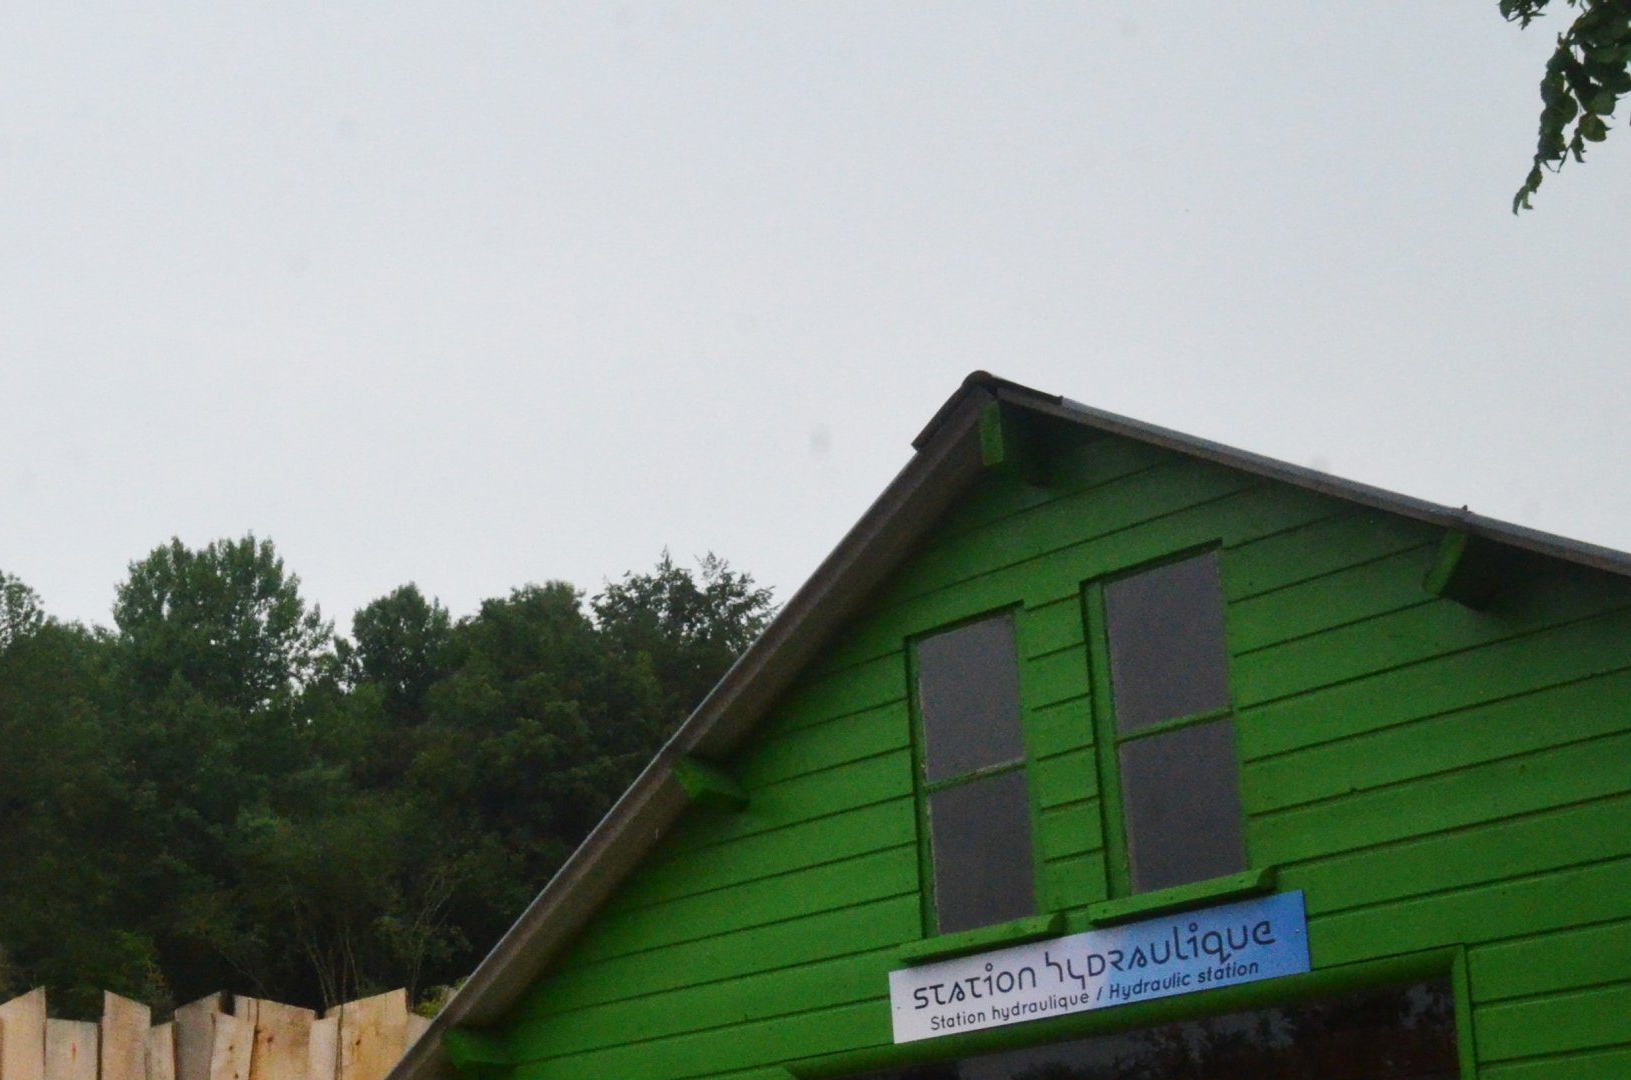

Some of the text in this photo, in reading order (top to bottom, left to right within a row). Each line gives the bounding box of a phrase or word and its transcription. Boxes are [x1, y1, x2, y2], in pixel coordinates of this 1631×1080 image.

[930, 1010, 986, 1031] Station
[992, 992, 1090, 1026] hydraulique
[1109, 971, 1191, 1000] Hydraulic
[1197, 962, 1259, 983] station
